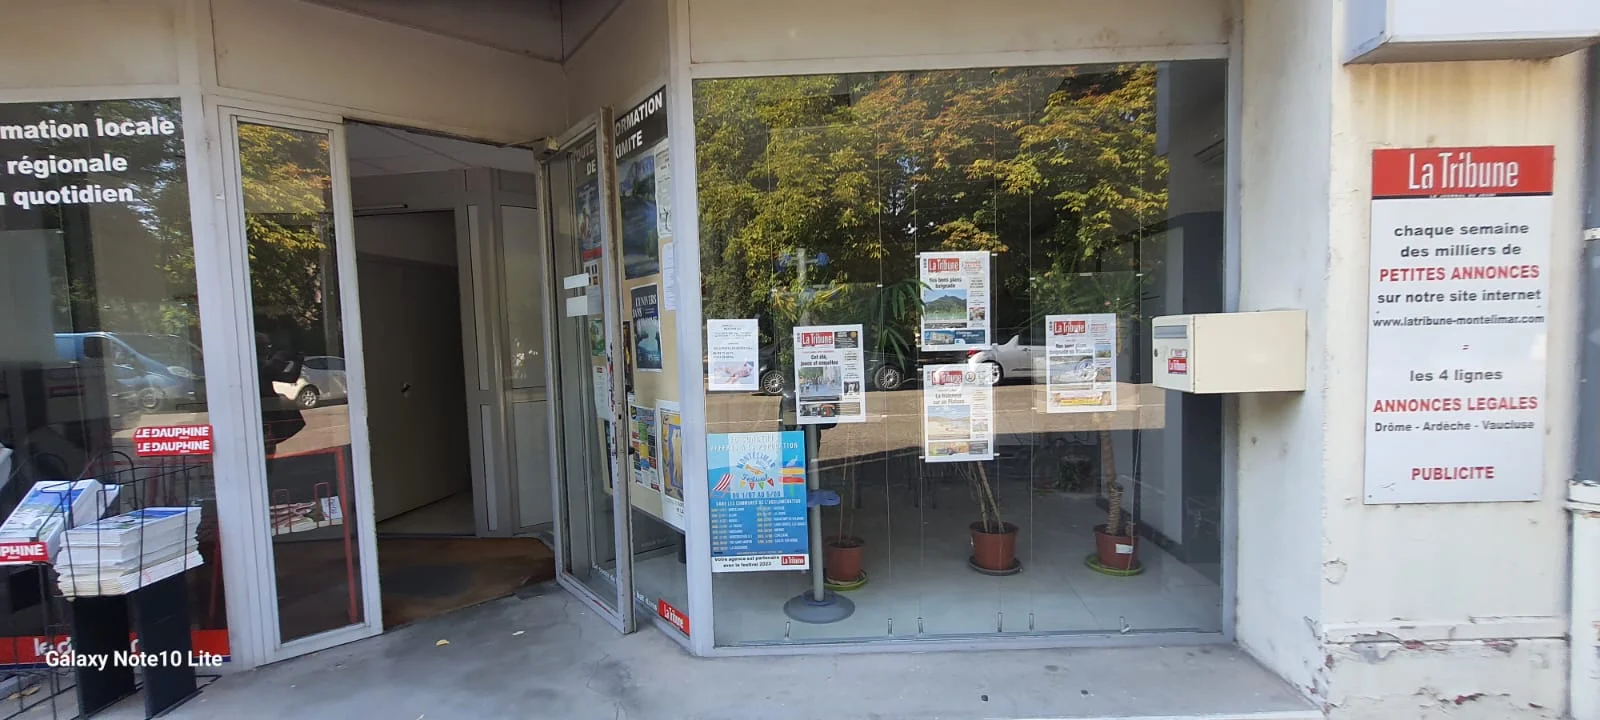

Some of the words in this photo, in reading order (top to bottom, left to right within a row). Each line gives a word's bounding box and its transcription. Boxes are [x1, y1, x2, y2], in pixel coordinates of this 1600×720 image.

[95, 116, 175, 137] locale
[7, 153, 128, 178] régionale
[586, 160, 596, 175] DE
[1408, 153, 1434, 189] La
[1438, 152, 1519, 188] Tribune
[13, 184, 133, 209] quotidien
[1394, 225, 1455, 238] chaque
[1460, 223, 1530, 235] semaine
[1400, 246, 1429, 257] des
[1435, 245, 1496, 256] milliers
[1502, 244, 1521, 255] de
[928, 259, 937, 271] La
[937, 258, 959, 271] Tribune
[1379, 267, 1446, 282] PETITES
[1450, 265, 1540, 280] ANNONCES
[1377, 293, 1401, 303] sur
[1405, 291, 1445, 302] notre
[1449, 290, 1477, 302] site
[1482, 289, 1542, 301] internet
[1054, 322, 1062, 333] La
[1063, 321, 1085, 334] Tribune
[1373, 314, 1545, 327] www.latribune-montelimar.com
[802, 333, 810, 345] La
[810, 332, 833, 345] Tribune
[1410, 370, 1433, 382] les
[1438, 369, 1449, 381] 4
[1454, 369, 1503, 383] lignes
[1373, 399, 1462, 413] ANNONCES
[1467, 396, 1538, 411] LEGALES
[135, 428, 151, 438] LE
[1374, 421, 1412, 432] Drôme
[1422, 421, 1471, 431] Ardèche
[1482, 420, 1535, 430] Vaucluse
[137, 442, 151, 452] LE
[1411, 466, 1495, 480] PUBLICITE
[0, 544, 45, 557] PHINÉ
[663, 603, 670, 619] La
[669, 606, 684, 629] Tribune
